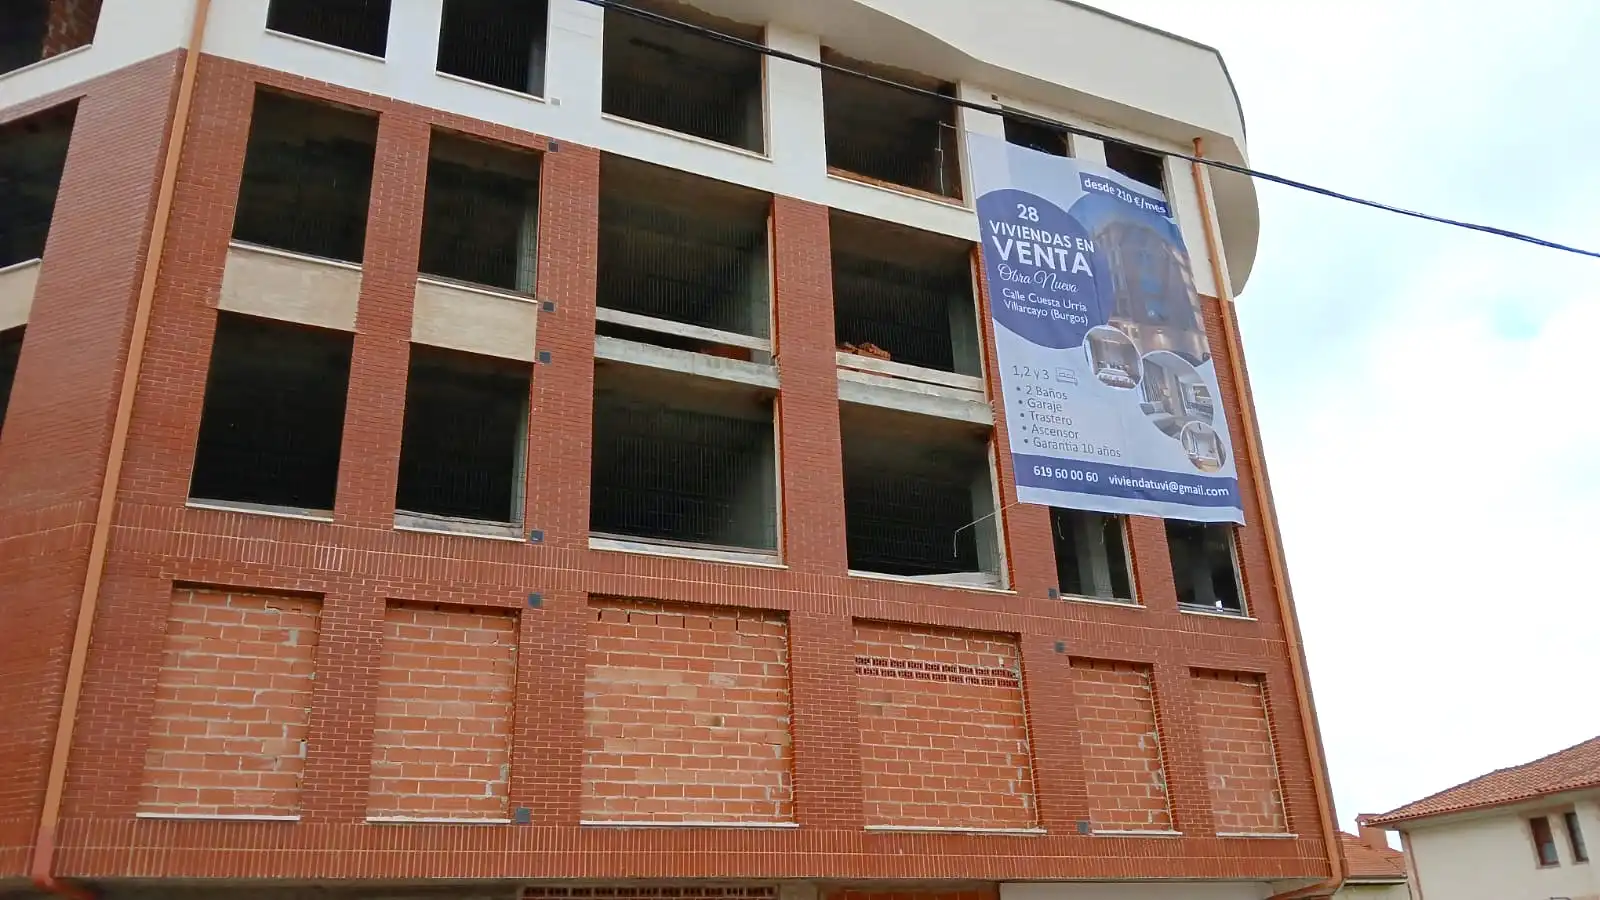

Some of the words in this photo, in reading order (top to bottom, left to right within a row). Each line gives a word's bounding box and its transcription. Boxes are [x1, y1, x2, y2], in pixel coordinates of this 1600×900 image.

[1084, 178, 1115, 194] desde
[1116, 188, 1132, 203] 210
[1134, 198, 1166, 213] €/mes
[1016, 203, 1040, 222] 28
[989, 219, 1072, 248] VIVIENDAS
[1075, 237, 1095, 253] EN
[992, 235, 1094, 278] VENTA
[997, 263, 1032, 285] Obra
[1033, 270, 1079, 293] Nueva
[1002, 287, 1026, 301] Calle
[1028, 292, 1061, 308] Cuesta
[1003, 299, 1048, 318] Villarcayo
[1050, 308, 1089, 327] (Burgos)
[1012, 365, 1032, 378] 1,2
[1033, 369, 1040, 380] y
[1041, 369, 1050, 380] 3
[1025, 384, 1033, 395] 2
[1035, 385, 1068, 401] Baños
[1027, 397, 1063, 413] Garaje
[1029, 410, 1073, 426] Trastero
[1031, 423, 1080, 440] Ascensor
[1081, 443, 1095, 454] 10
[1097, 444, 1121, 458] años
[1033, 465, 1053, 477] 619
[1054, 468, 1068, 479] 60
[1070, 469, 1084, 481] 00
[1085, 471, 1099, 482] 60
[1108, 474, 1230, 497] viviendatuvi@gmail.com
